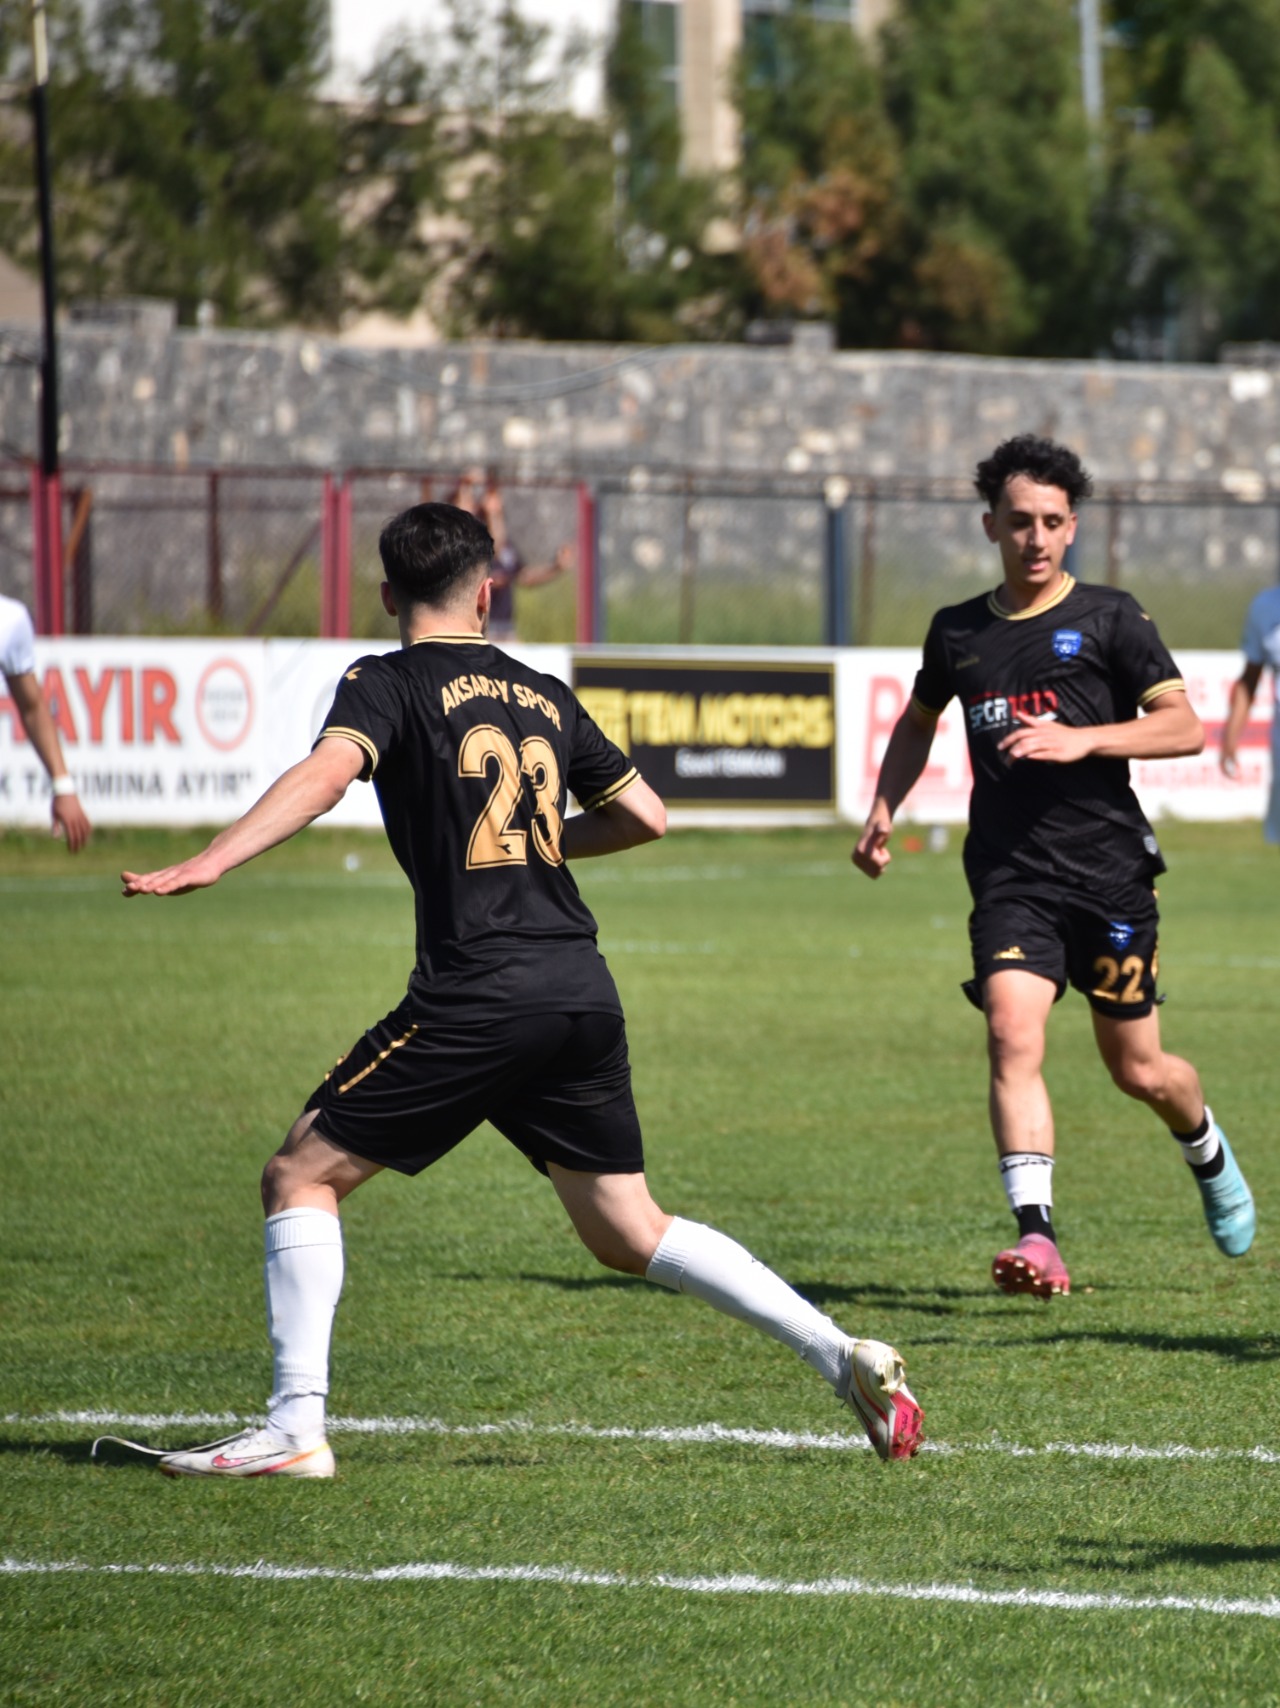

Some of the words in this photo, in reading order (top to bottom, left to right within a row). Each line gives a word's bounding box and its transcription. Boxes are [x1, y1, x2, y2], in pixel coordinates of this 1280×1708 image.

[512, 683, 562, 732] SPOR
[25, 771, 163, 795] TAIMINA
[458, 724, 564, 870] 23
[1094, 955, 1145, 1003] 22
